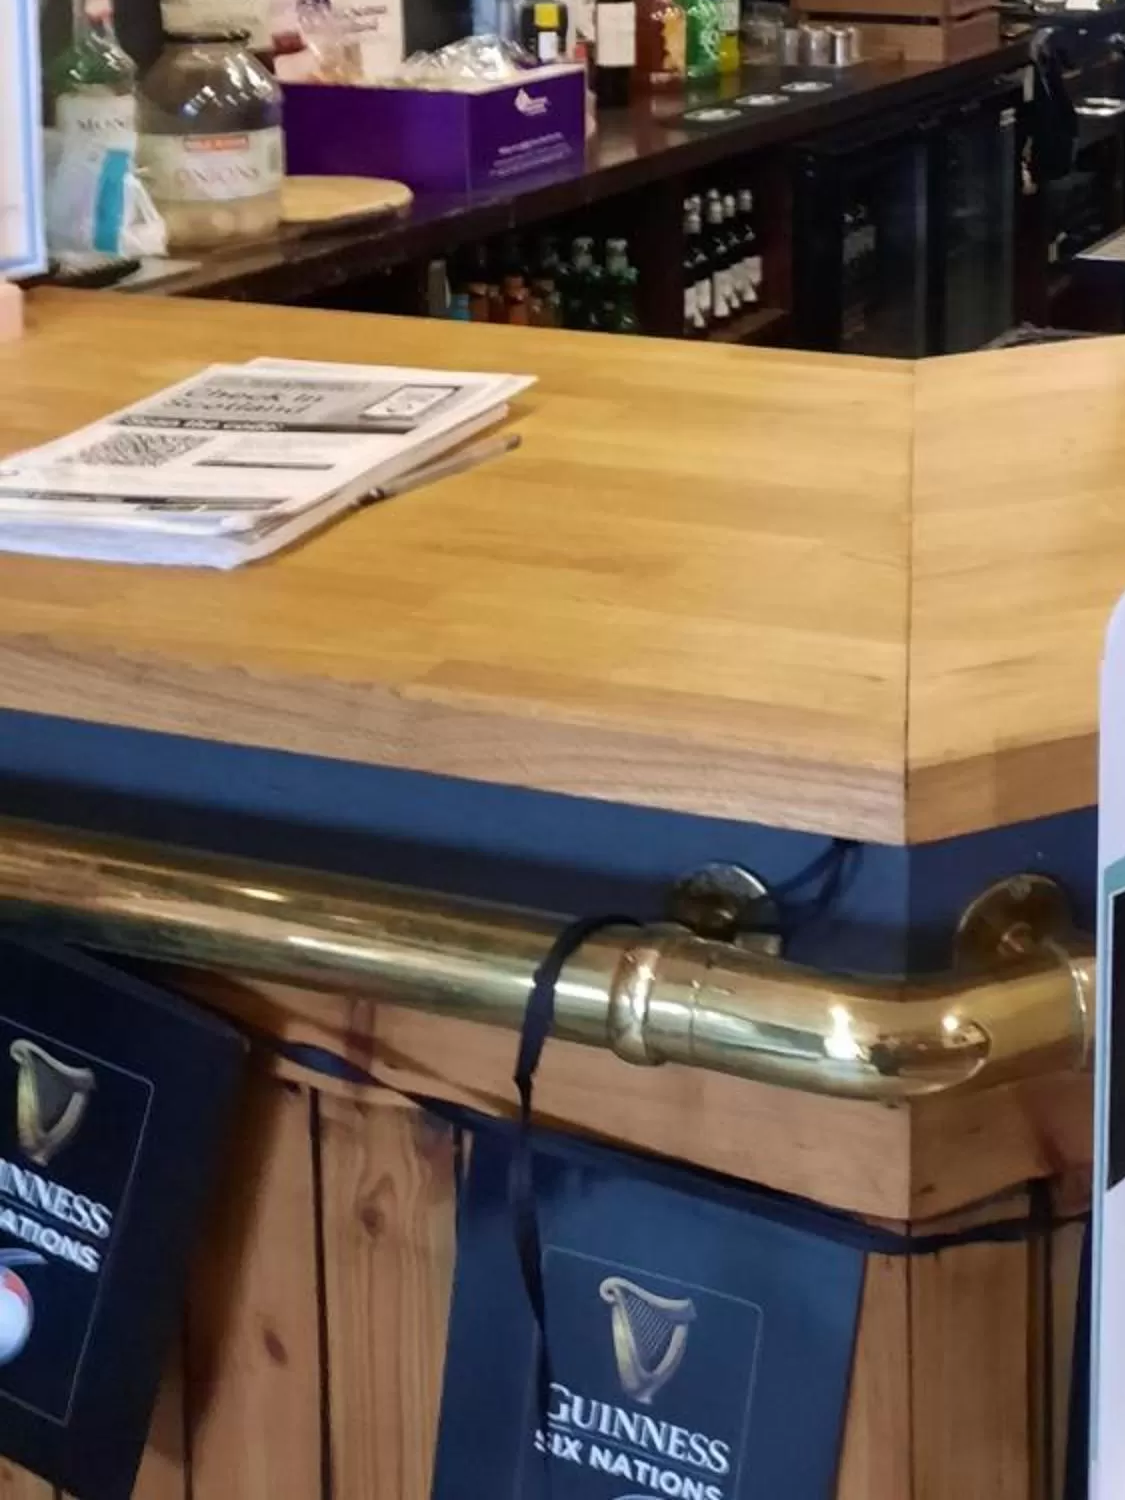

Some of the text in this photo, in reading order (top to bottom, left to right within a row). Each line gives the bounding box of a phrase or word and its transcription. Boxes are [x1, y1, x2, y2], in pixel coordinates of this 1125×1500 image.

[0, 1204, 102, 1274] ATIONS
[547, 1380, 732, 1476] GUINNESS
[588, 1444, 725, 1500] NATIONS
